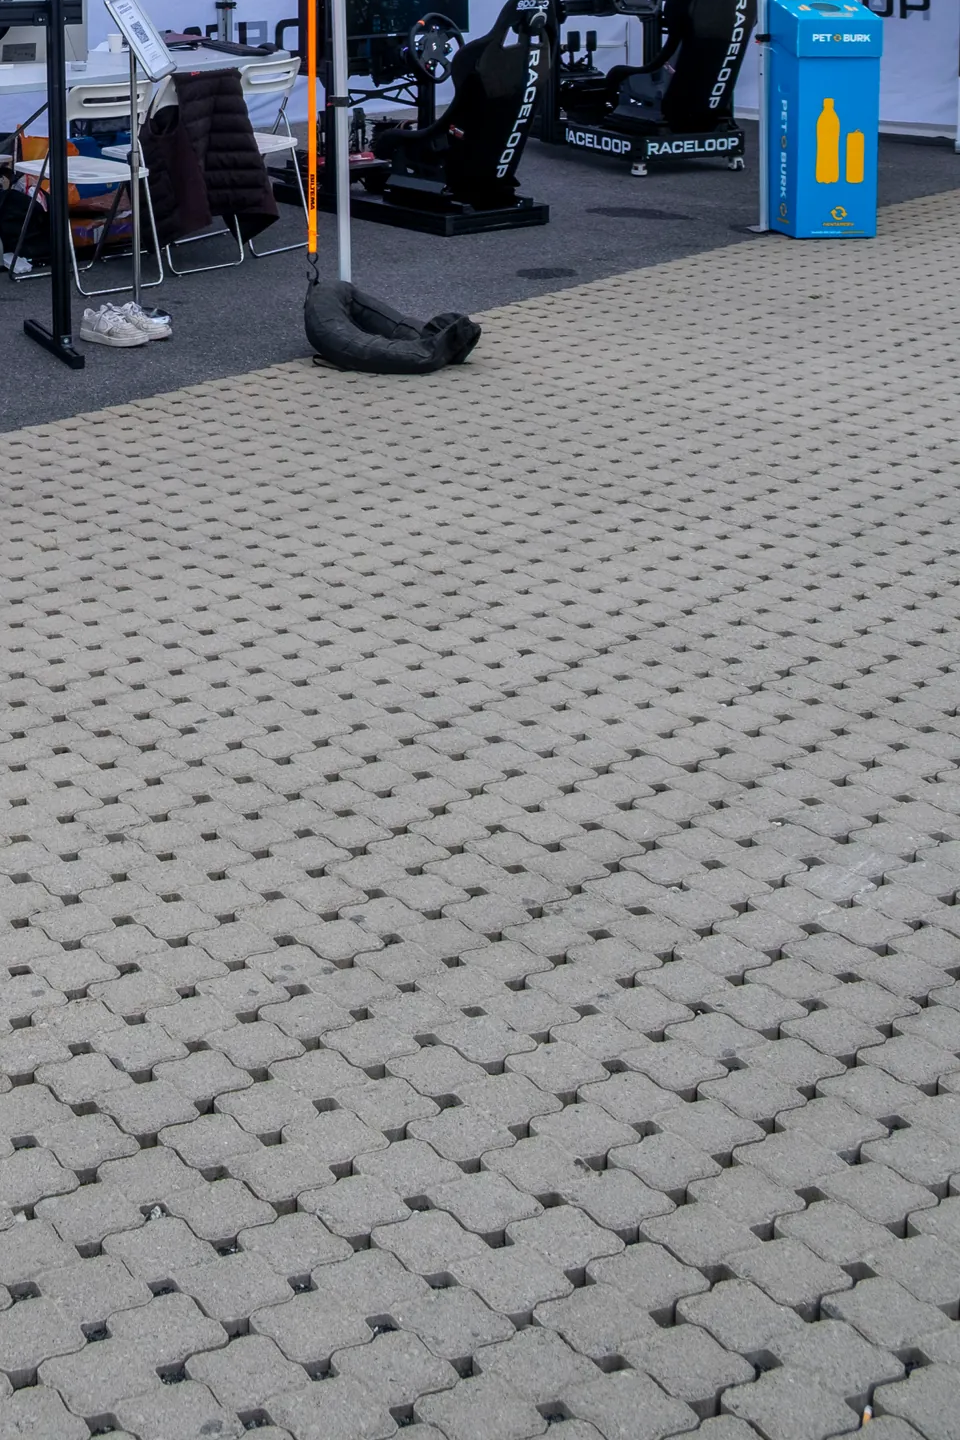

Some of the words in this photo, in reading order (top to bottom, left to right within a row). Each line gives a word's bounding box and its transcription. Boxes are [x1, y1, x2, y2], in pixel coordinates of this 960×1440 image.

[813, 34, 832, 42] PET
[844, 34, 871, 42] BURK
[495, 50, 539, 178] RACELOOP
[647, 136, 739, 155] RACELOOP
